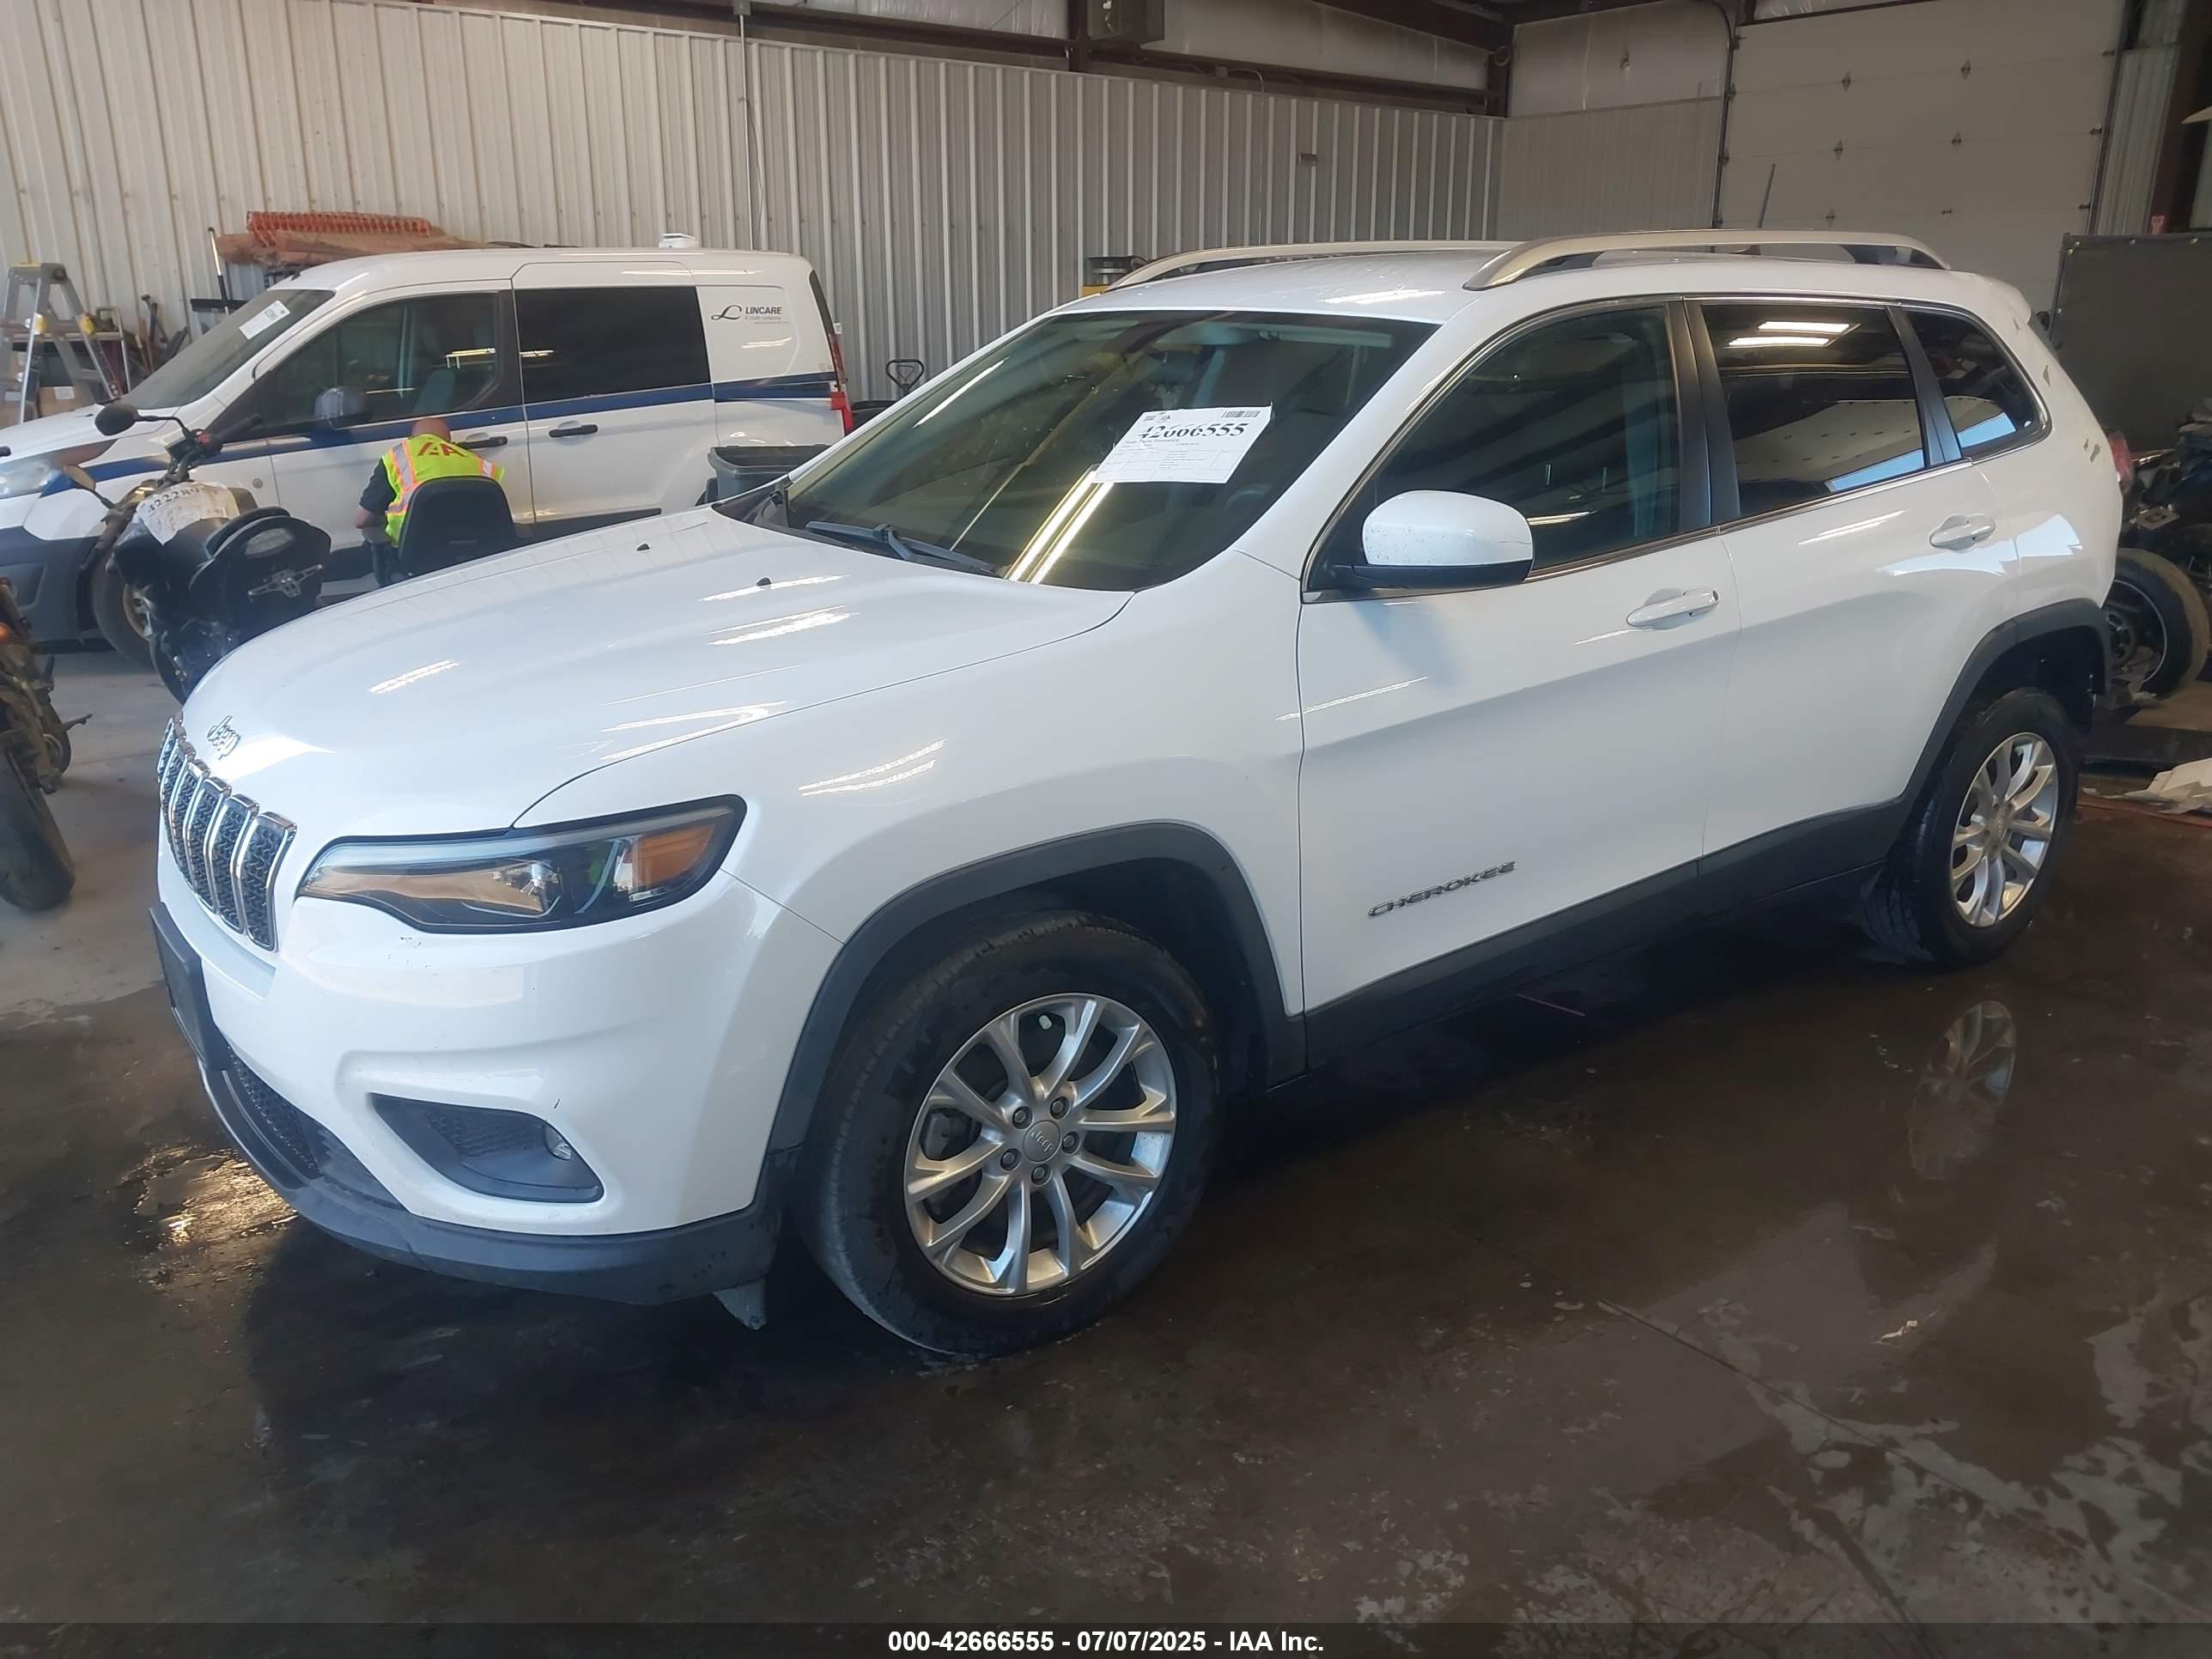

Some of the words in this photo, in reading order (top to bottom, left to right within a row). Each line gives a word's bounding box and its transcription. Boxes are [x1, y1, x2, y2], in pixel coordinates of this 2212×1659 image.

[1137, 422, 1250, 439] 42666555
[206, 714, 241, 761] Jeep
[1367, 860, 1516, 916] CHEROKEE
[1030, 1130, 1054, 1152] Jeep
